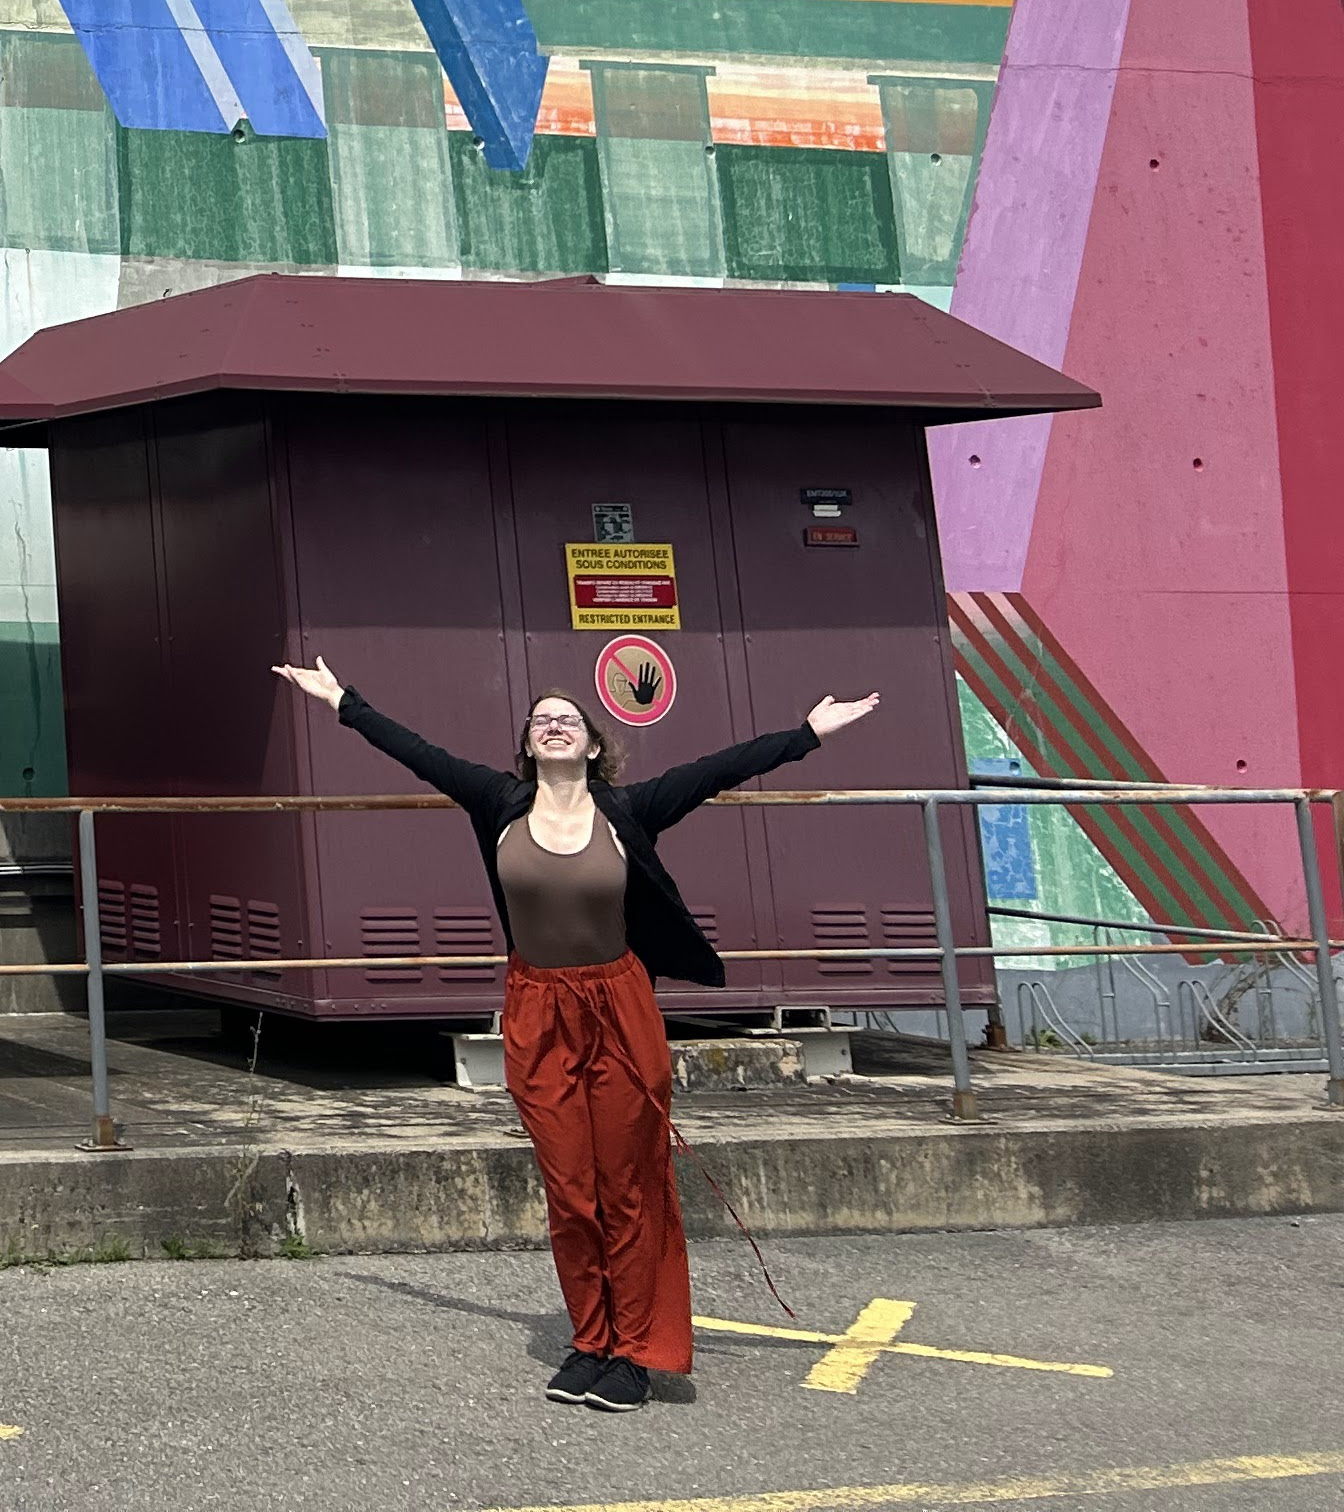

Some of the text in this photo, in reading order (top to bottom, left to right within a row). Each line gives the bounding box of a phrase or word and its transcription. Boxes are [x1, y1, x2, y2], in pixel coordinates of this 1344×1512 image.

[571, 549, 669, 559] ENTREE AUTORISEE
[576, 560, 667, 569] SOUS CONDITIONS
[578, 614, 675, 624] RESTRICTED ENTRANCE
